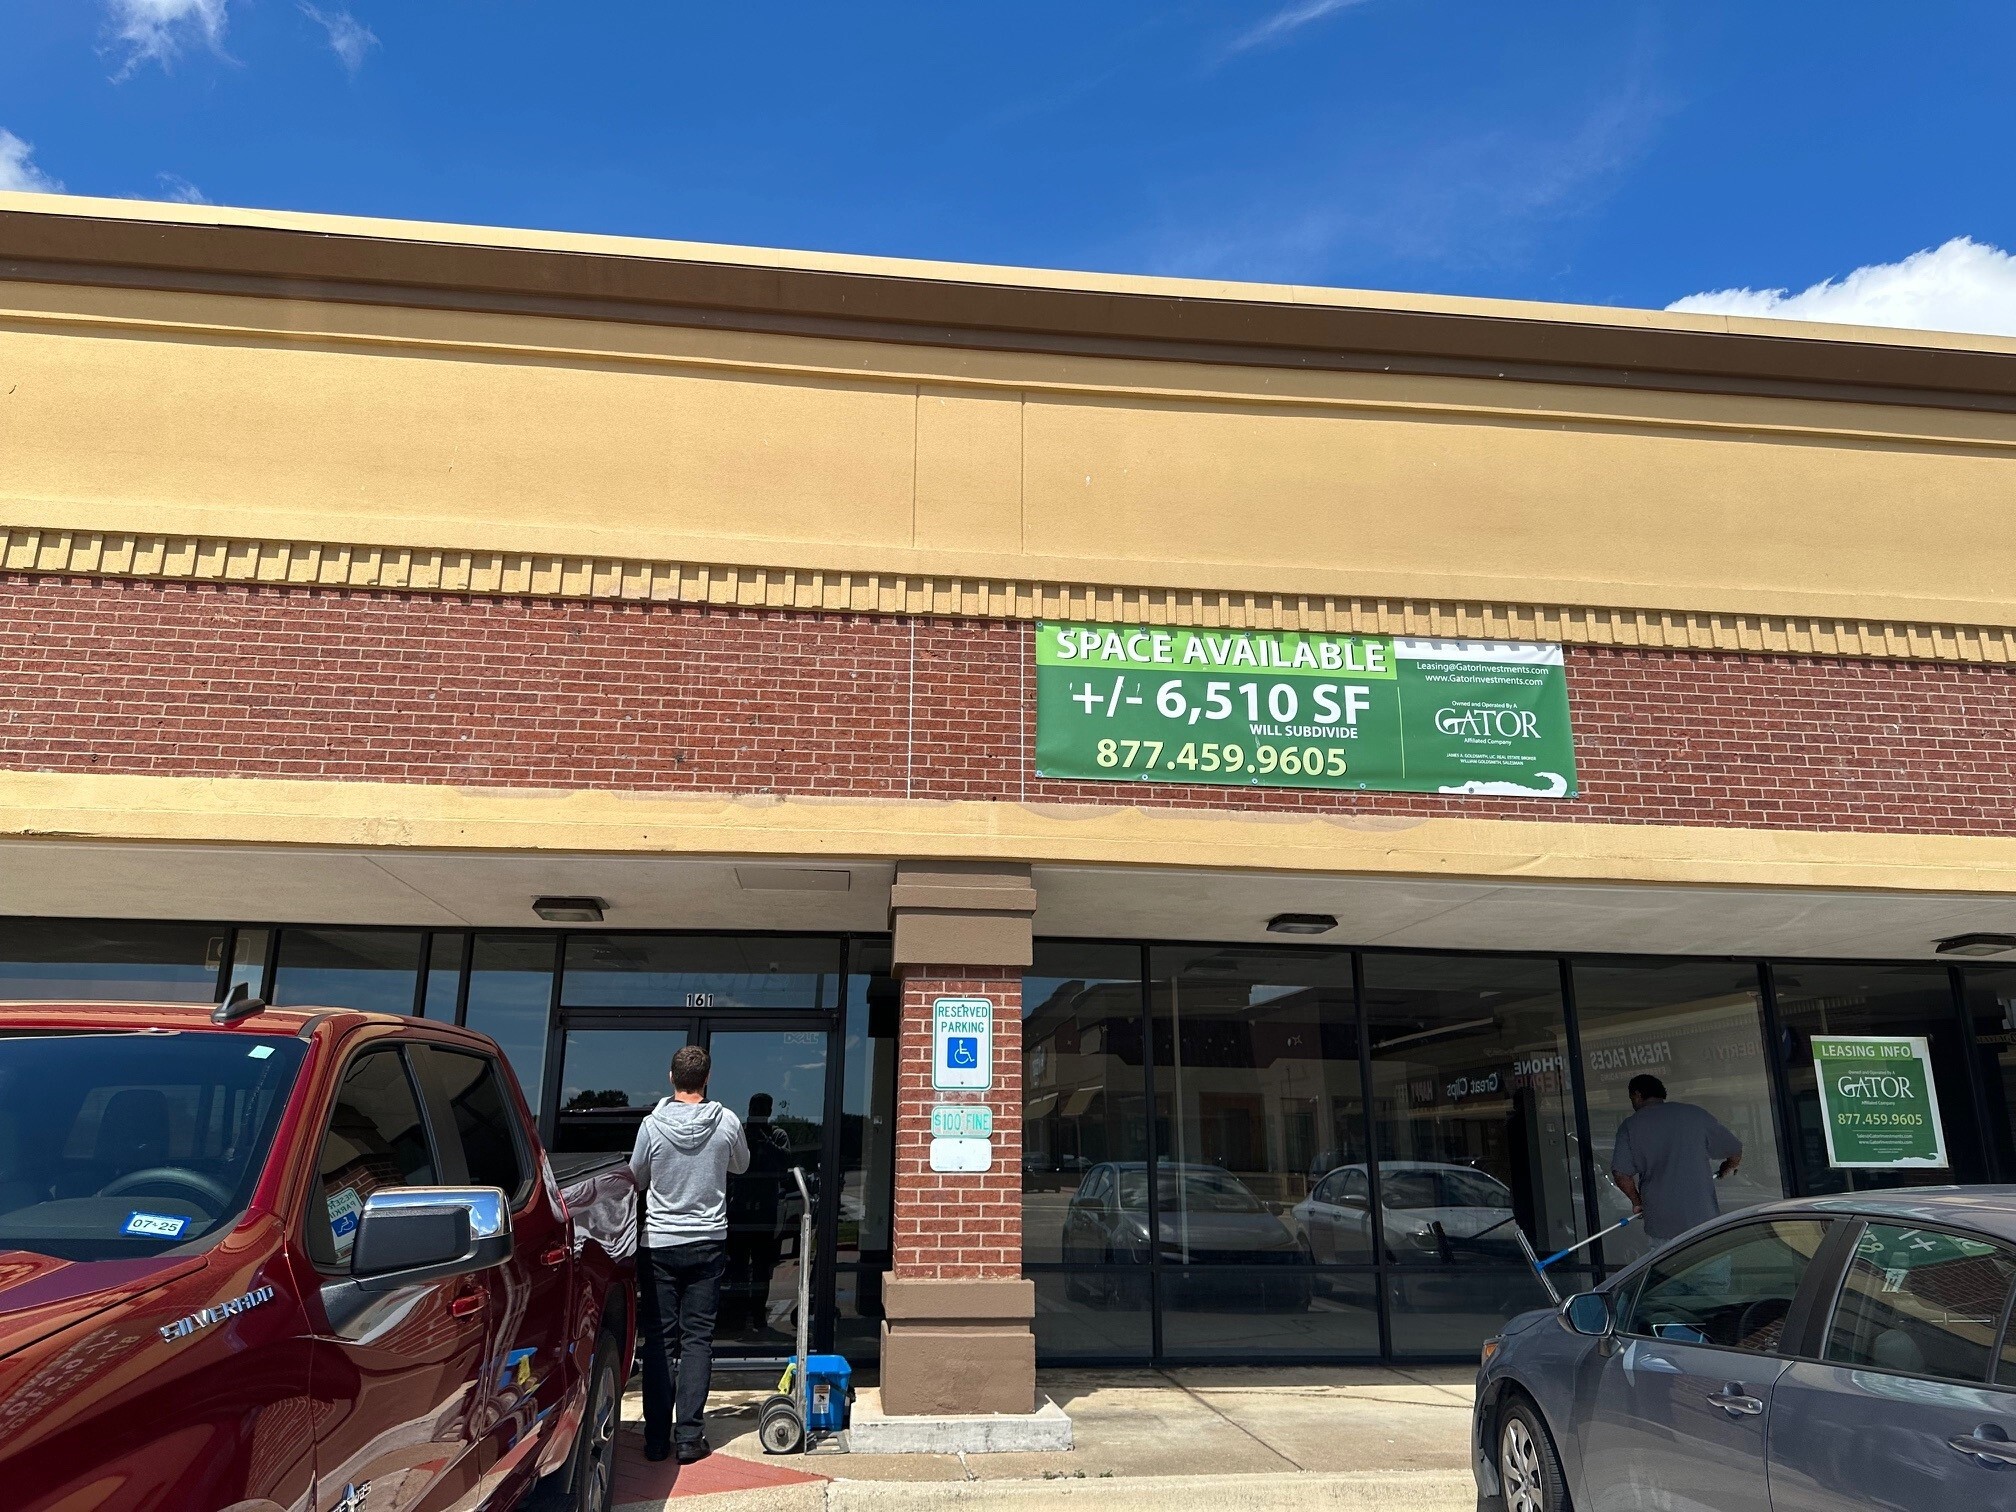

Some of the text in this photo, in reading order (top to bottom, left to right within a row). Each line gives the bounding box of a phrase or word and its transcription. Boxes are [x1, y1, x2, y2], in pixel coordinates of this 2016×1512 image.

[1056, 630, 1388, 673] SPACE AVAILABLE
[1416, 661, 1549, 675] Leasing@GatorInvestments.com
[1425, 674, 1543, 686] www.GatorInvestments.com
[1156, 679, 1299, 726] 6,510
[1312, 683, 1370, 725] SF
[1434, 707, 1542, 739] GATOR
[1249, 724, 1358, 739] WILL SUBDIVIDE
[1487, 738, 1512, 747] Company
[1096, 738, 1348, 777] 877.459.9605
[686, 994, 714, 1008] 161
[938, 1006, 988, 1018] RESERVED
[940, 1021, 985, 1034] PARKING
[1821, 1045, 1911, 1058] LEASING INFO
[1837, 1076, 1915, 1098] GATOR
[934, 1112, 990, 1131] $100 FINE
[1837, 1113, 1923, 1126] 877.459.9605
[132, 1219, 179, 1232] 07 25
[159, 1284, 275, 1343] SILVERADO
